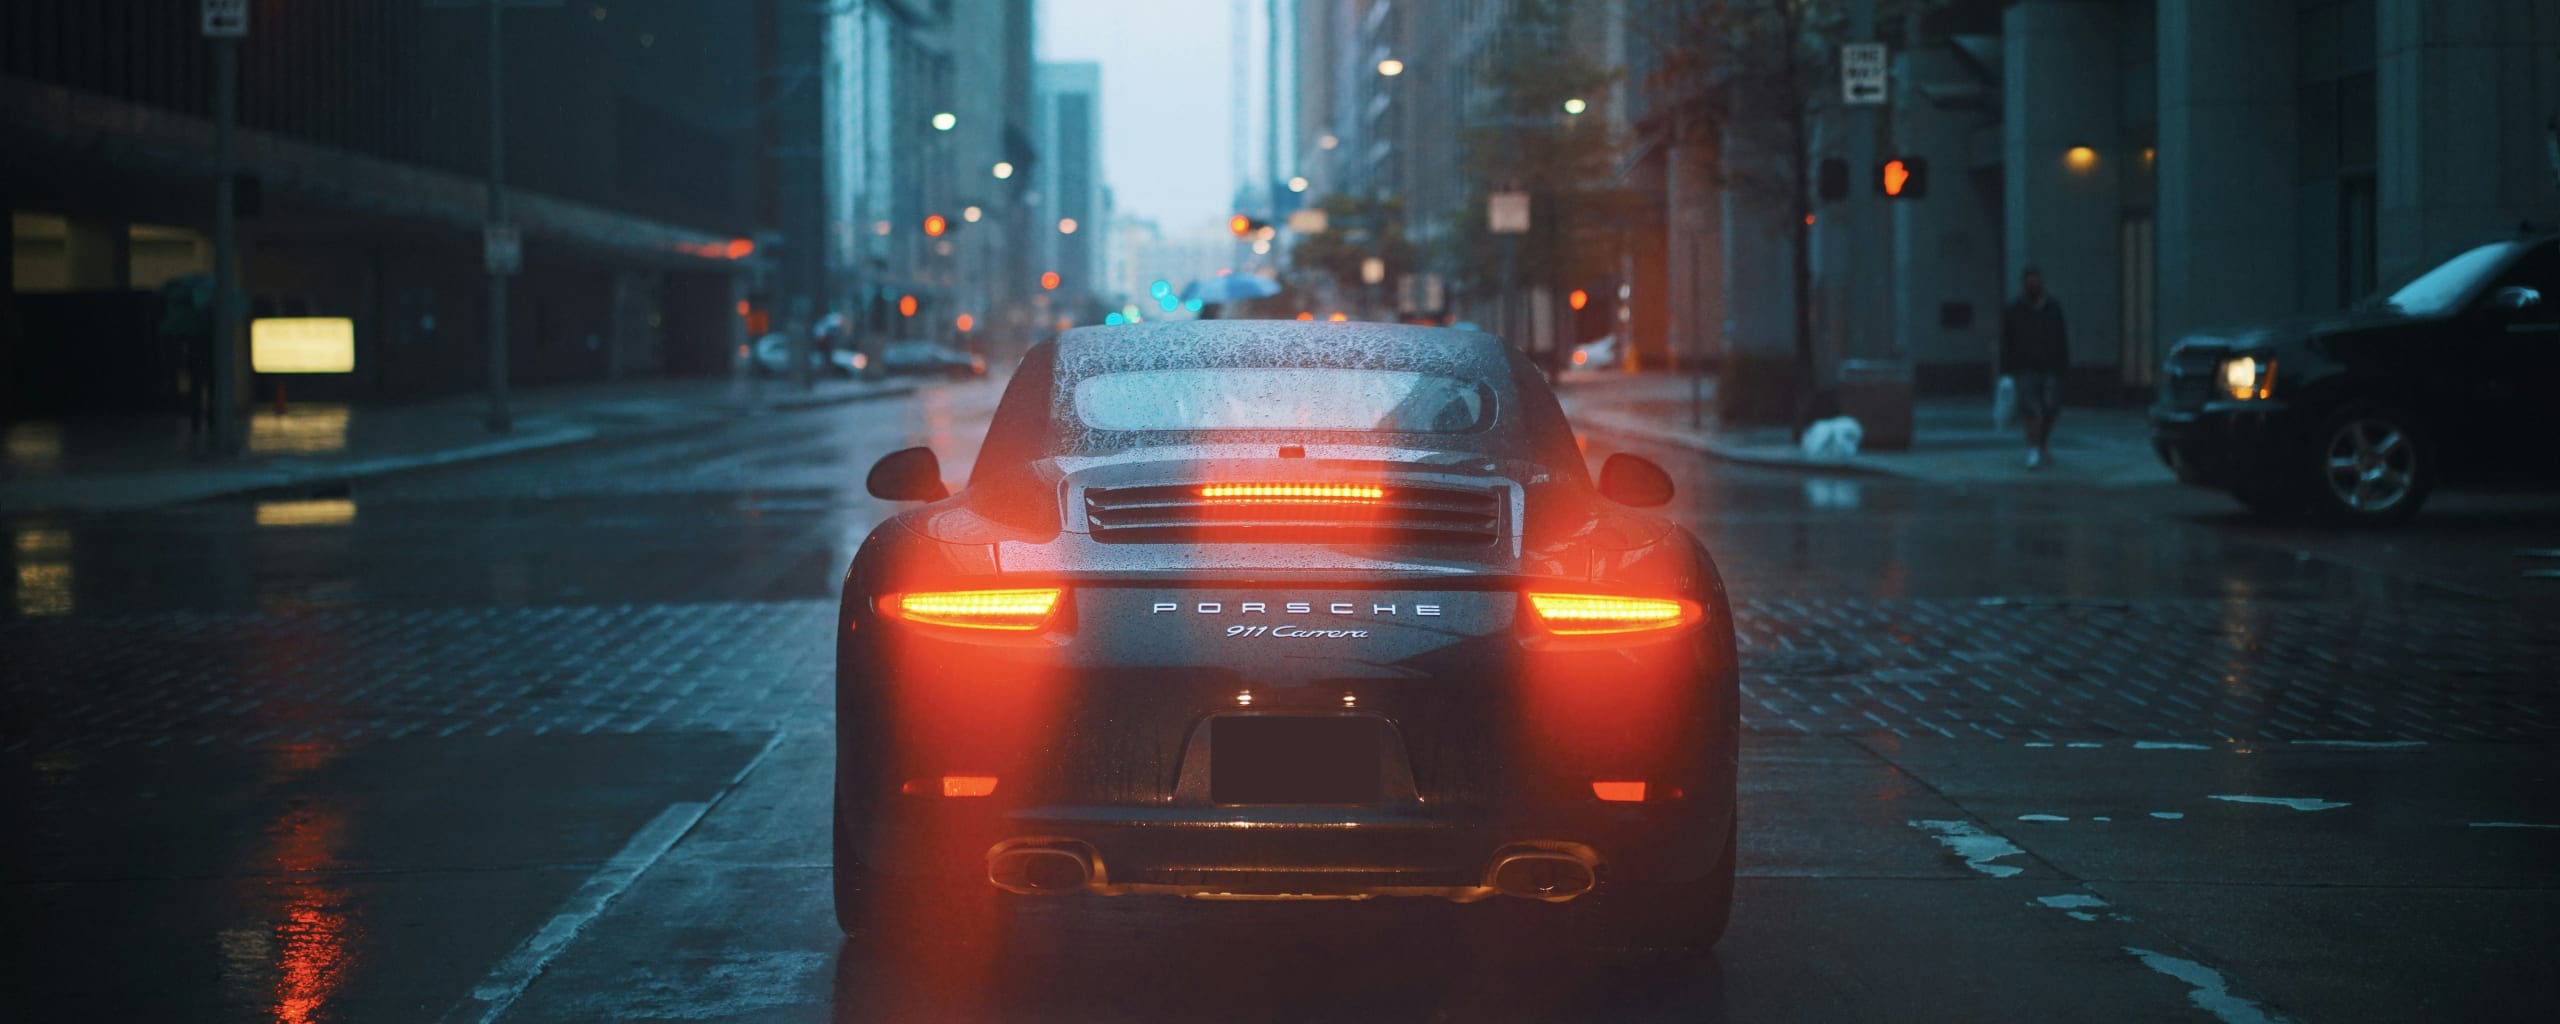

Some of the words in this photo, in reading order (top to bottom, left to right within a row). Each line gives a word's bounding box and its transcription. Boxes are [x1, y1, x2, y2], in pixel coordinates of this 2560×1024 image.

[1849, 48, 1880, 62] ONE
[1153, 602, 1441, 616] PORSCHE
[1226, 625, 1268, 638] 911
[1272, 625, 1369, 638] Carrera
